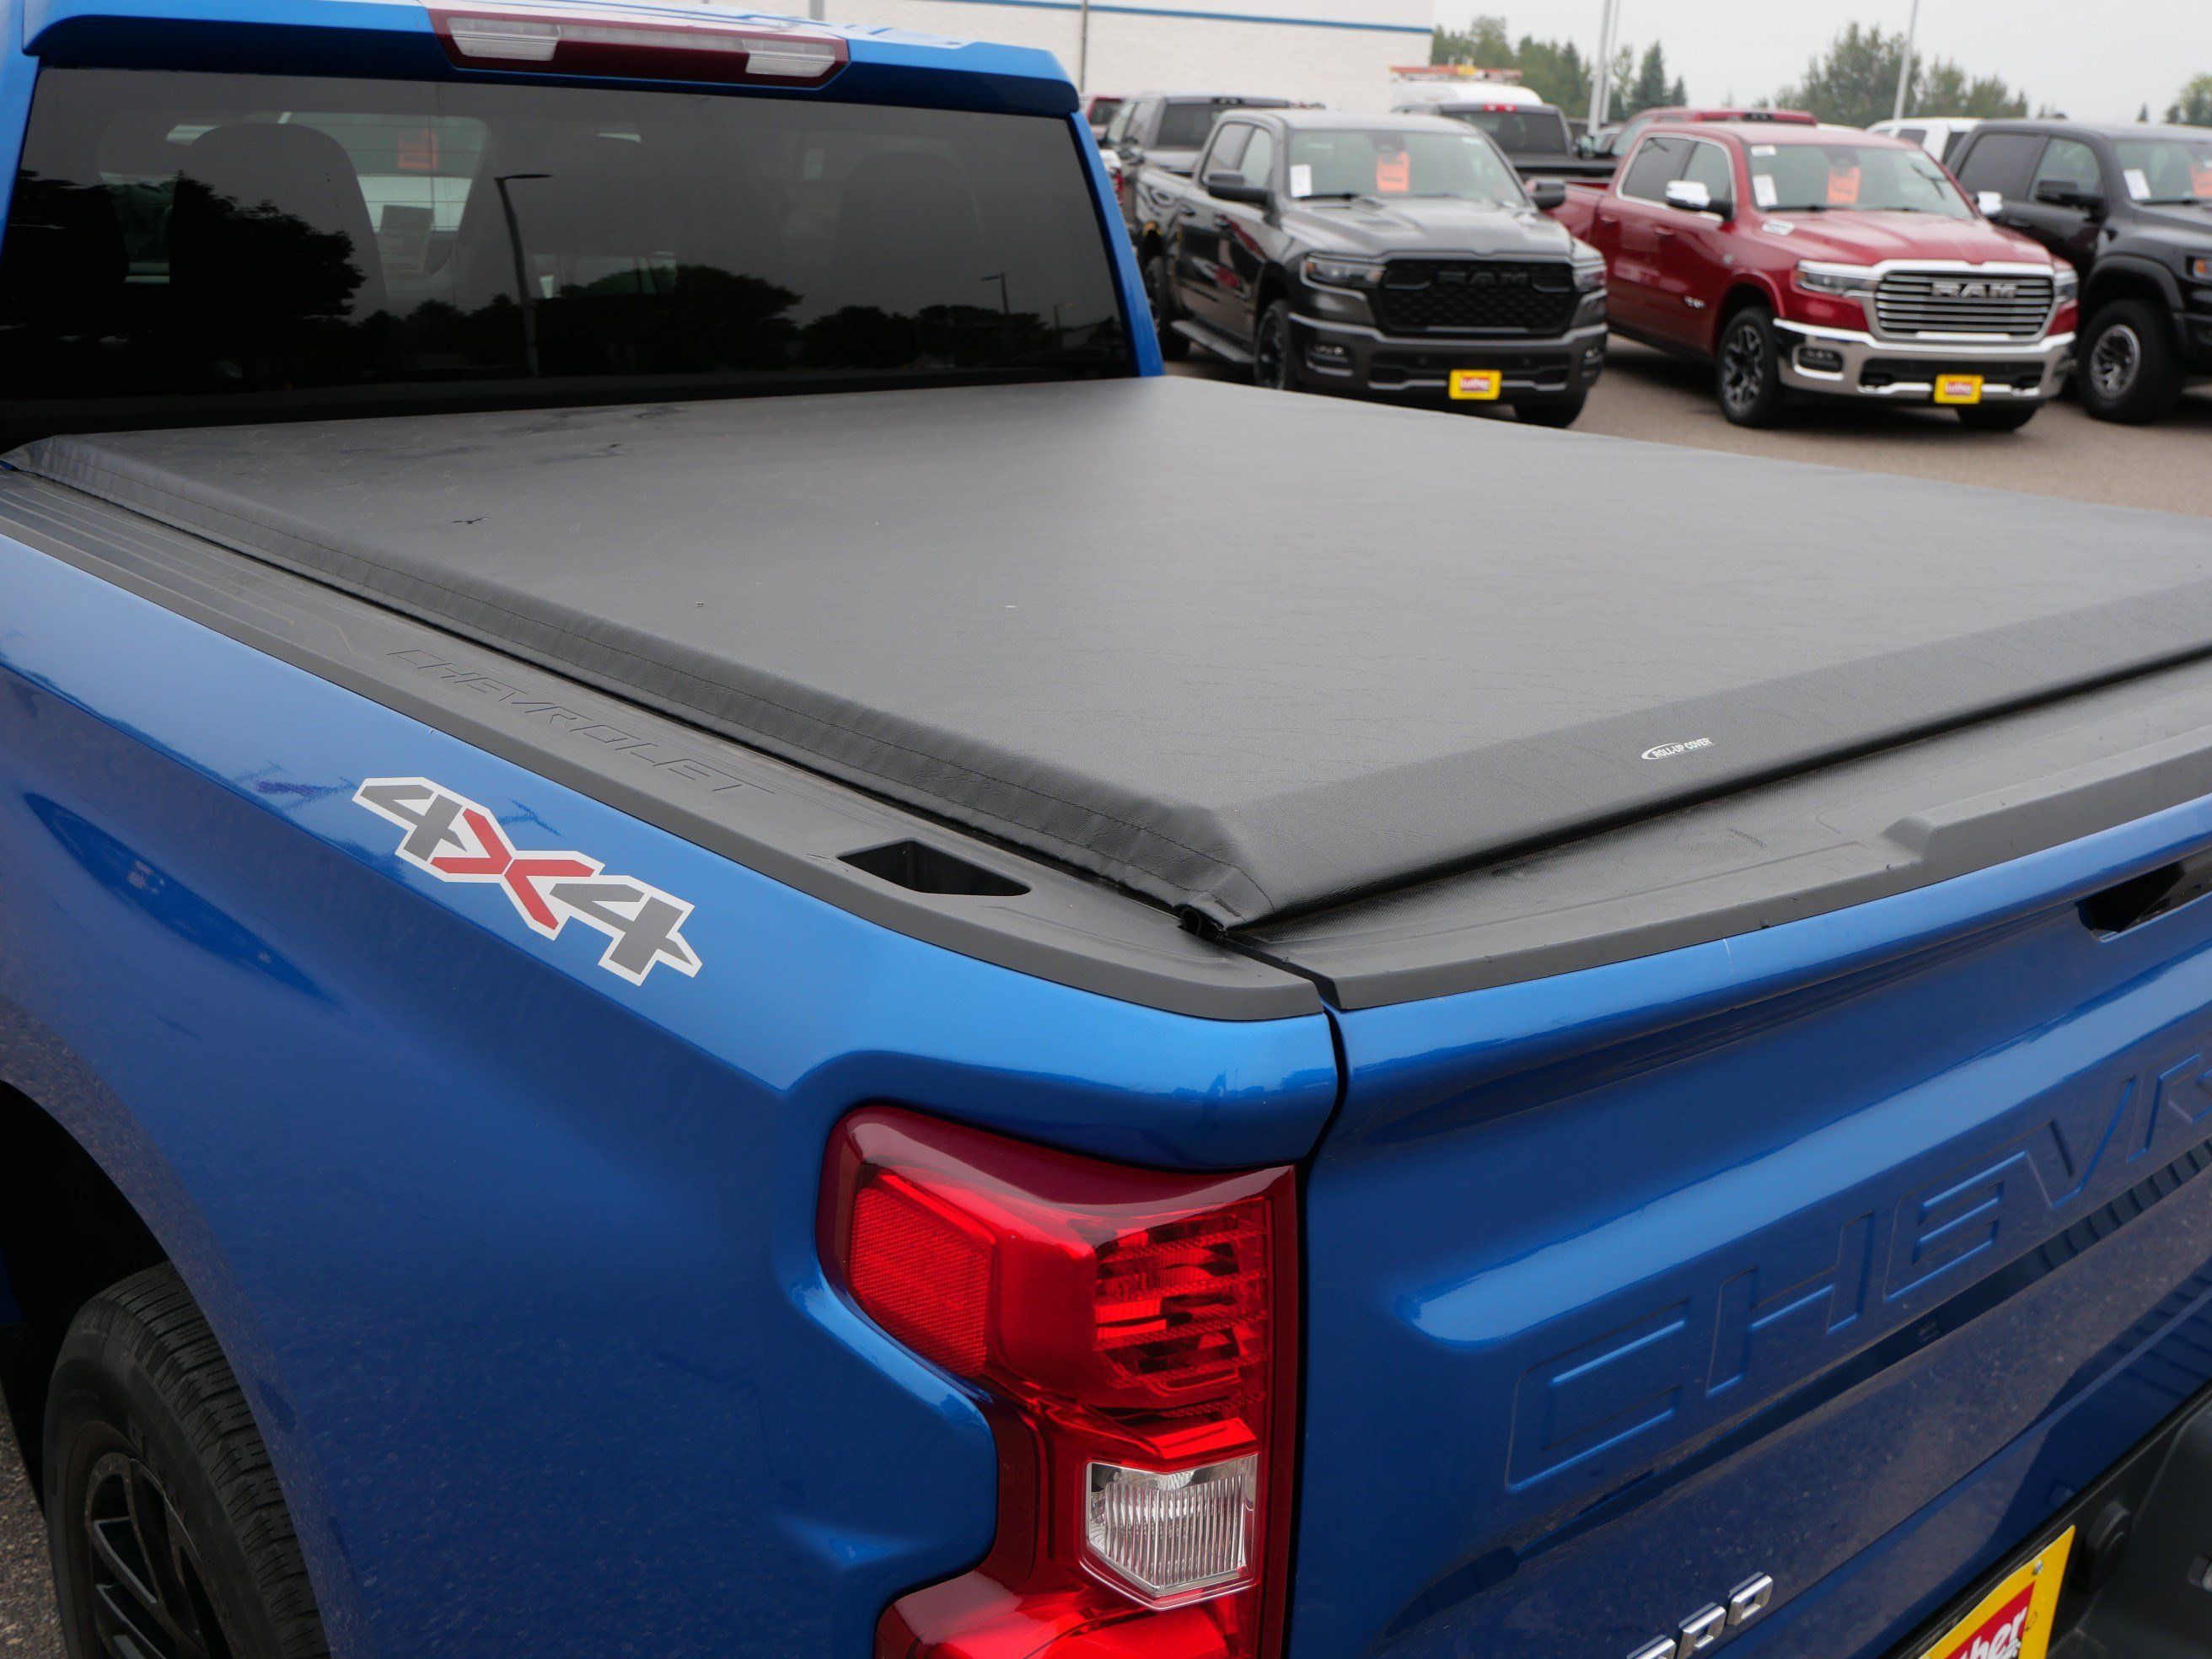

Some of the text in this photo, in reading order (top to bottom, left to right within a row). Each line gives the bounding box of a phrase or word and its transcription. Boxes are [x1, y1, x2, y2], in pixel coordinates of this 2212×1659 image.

[1438, 271, 1529, 287] RAM
[1932, 281, 2016, 298] RAM
[387, 649, 776, 795] CHEVROLET
[1651, 737, 1713, 759] ROLL-UP COVER
